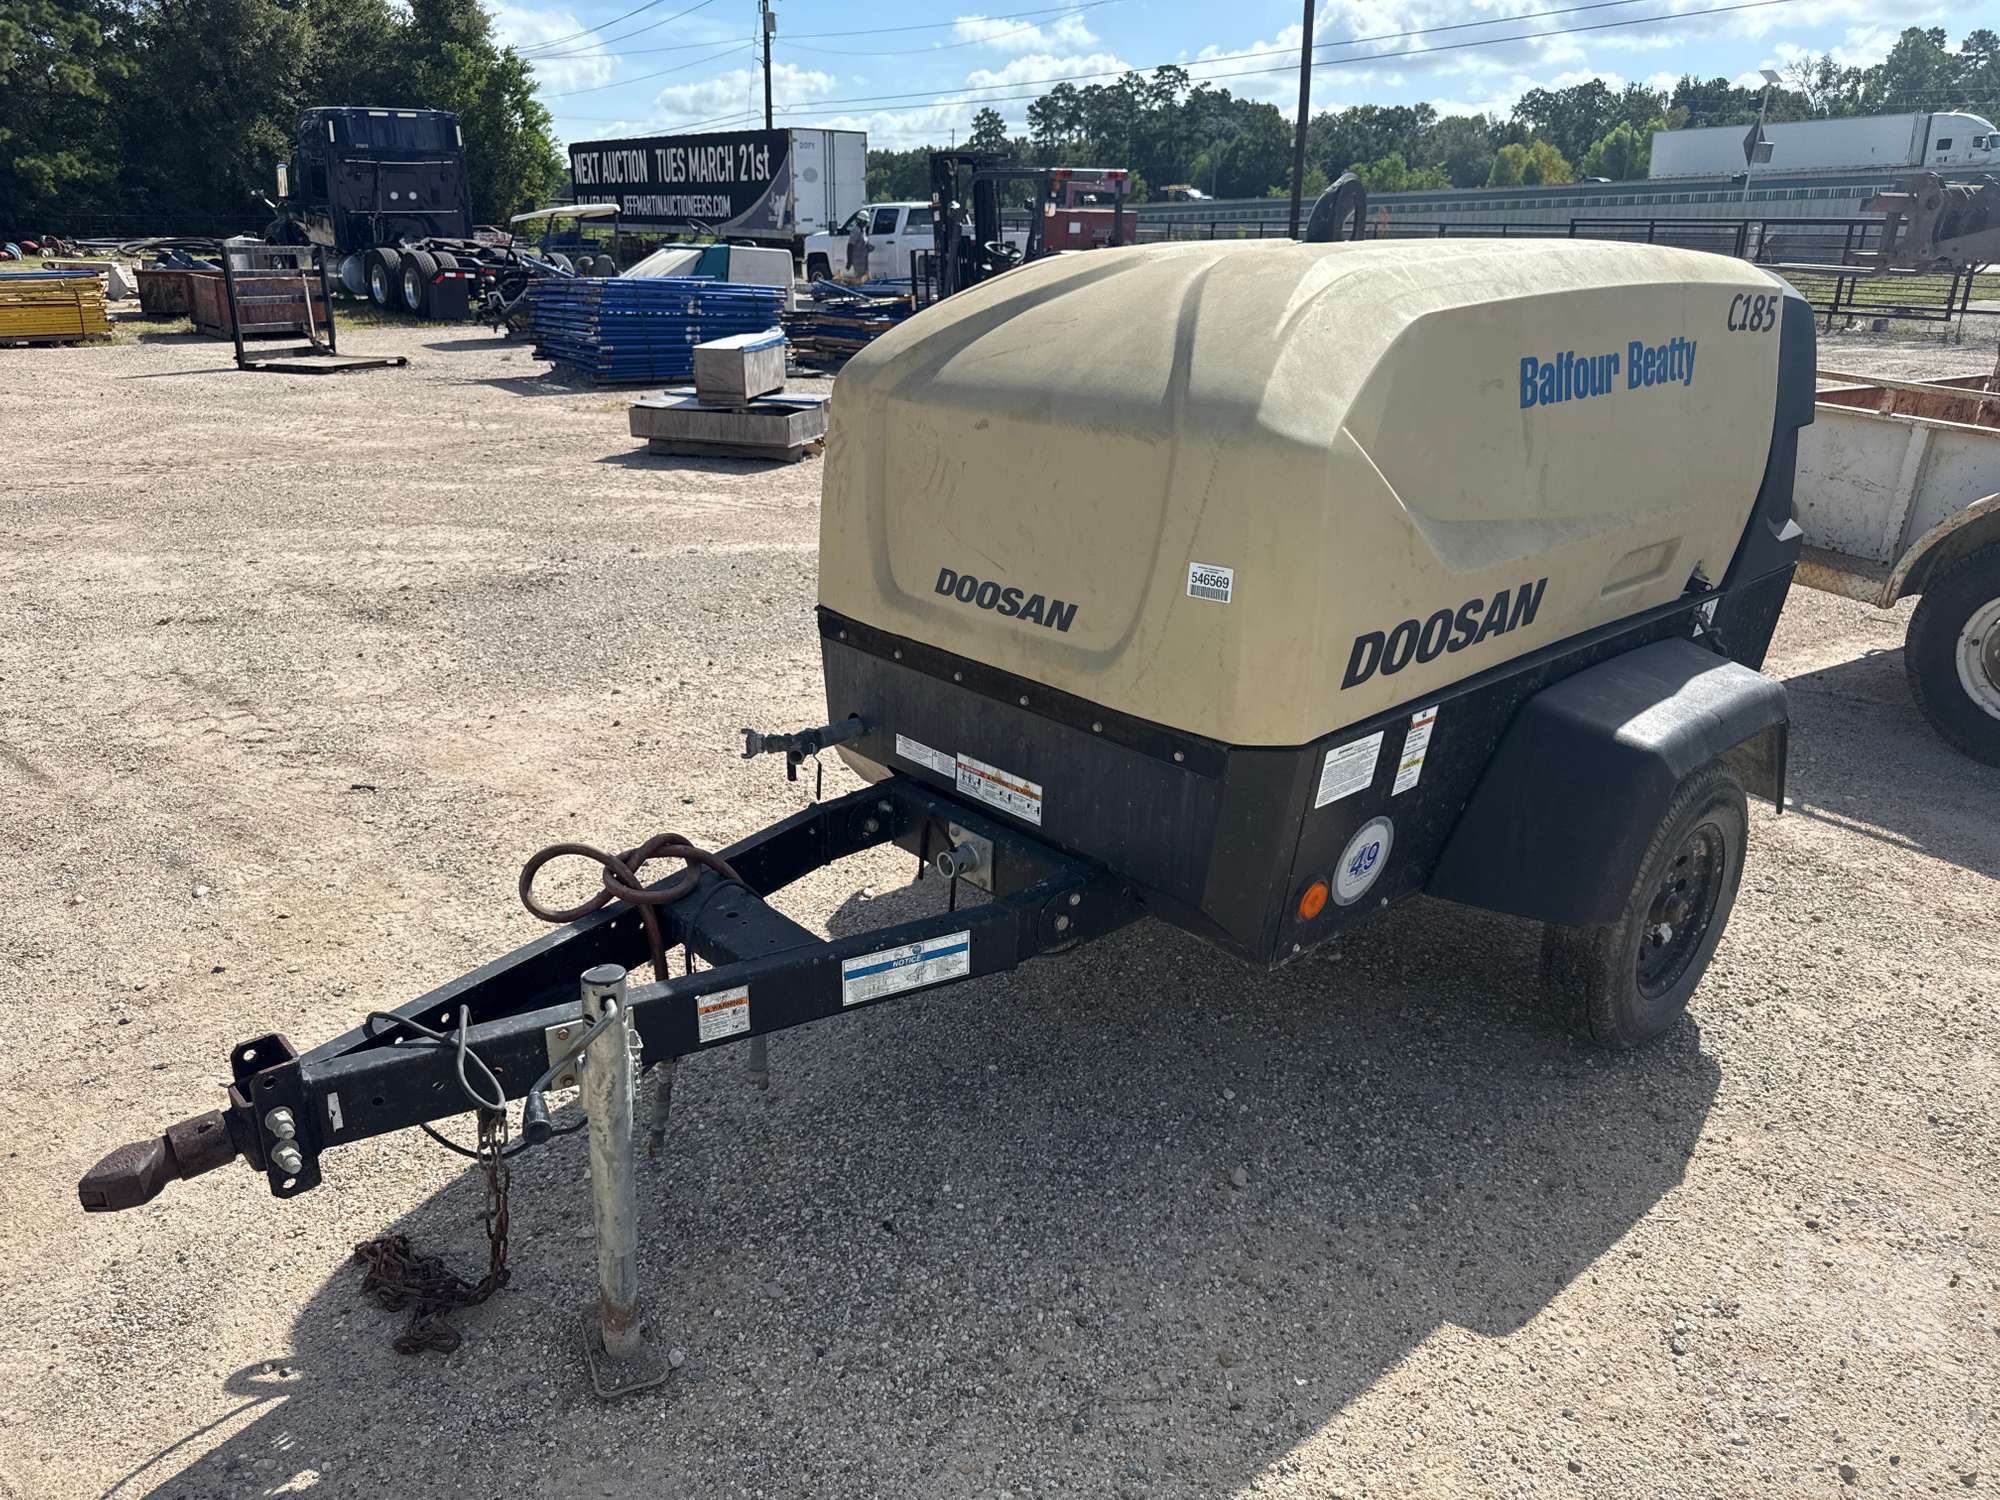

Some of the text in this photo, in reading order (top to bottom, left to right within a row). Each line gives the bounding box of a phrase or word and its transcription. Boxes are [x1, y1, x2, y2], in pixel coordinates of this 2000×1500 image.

[574, 143, 771, 184] NEXT AUCTION TUES MARCH 21st
[622, 195, 731, 218] JEFFMARTINAUCTIONEERS.COM
[1727, 293, 1777, 332] C185
[1519, 336, 1697, 409] Balfour Beatty
[934, 567, 1079, 633] DOOSAN
[1191, 572, 1229, 589] 546569
[1340, 577, 1548, 690] DOOSAN
[1349, 841, 1380, 876] 49
[892, 954, 921, 968] NOTICE
